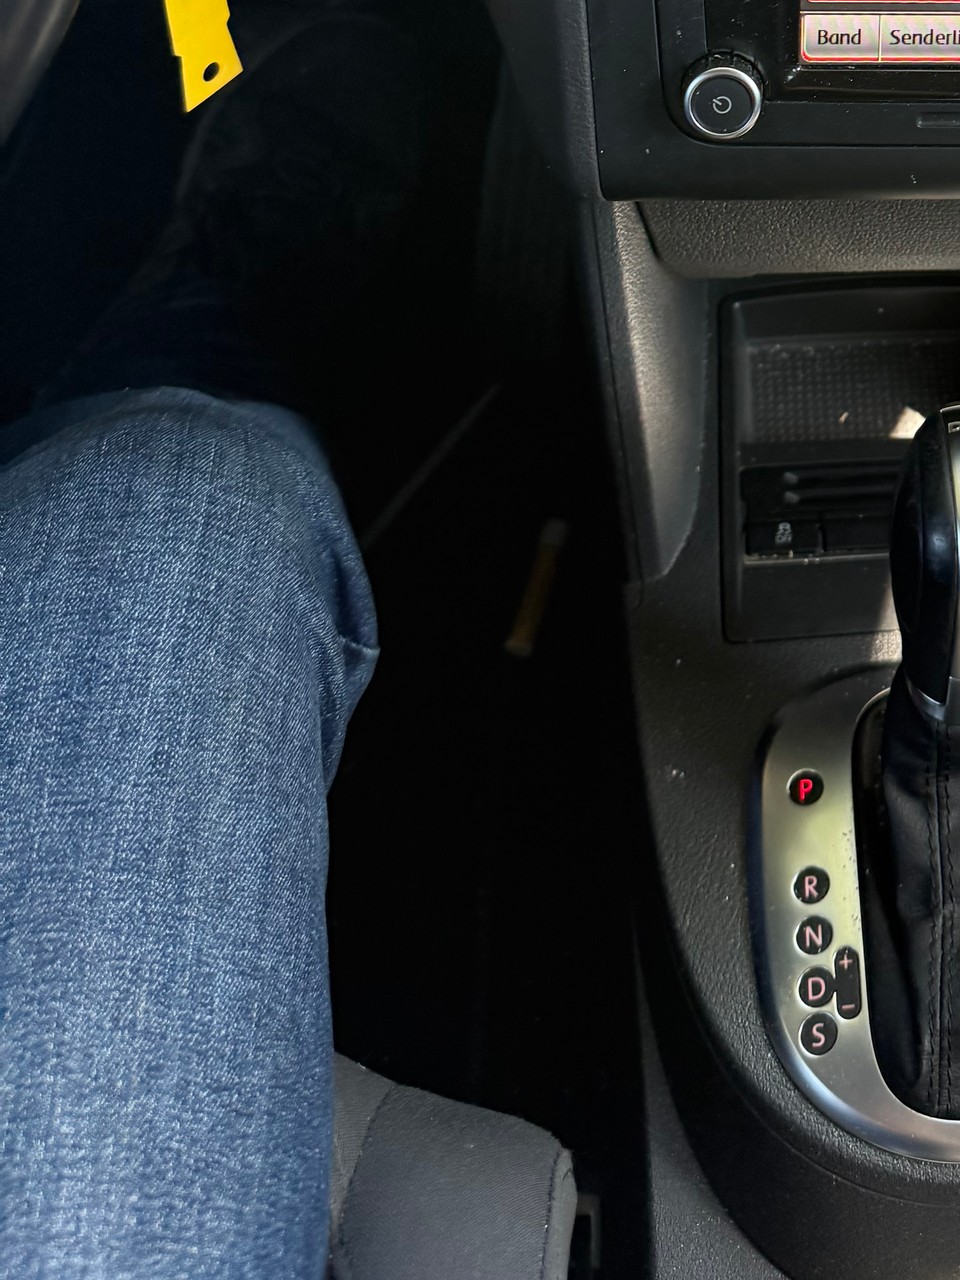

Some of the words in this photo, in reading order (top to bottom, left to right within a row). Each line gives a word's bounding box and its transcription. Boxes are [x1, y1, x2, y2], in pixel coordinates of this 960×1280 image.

[817, 29, 862, 45] Band
[799, 778, 813, 802] P
[804, 875, 819, 899] R
[805, 925, 823, 948] N
[808, 977, 826, 1001] D
[812, 1022, 826, 1049] S
